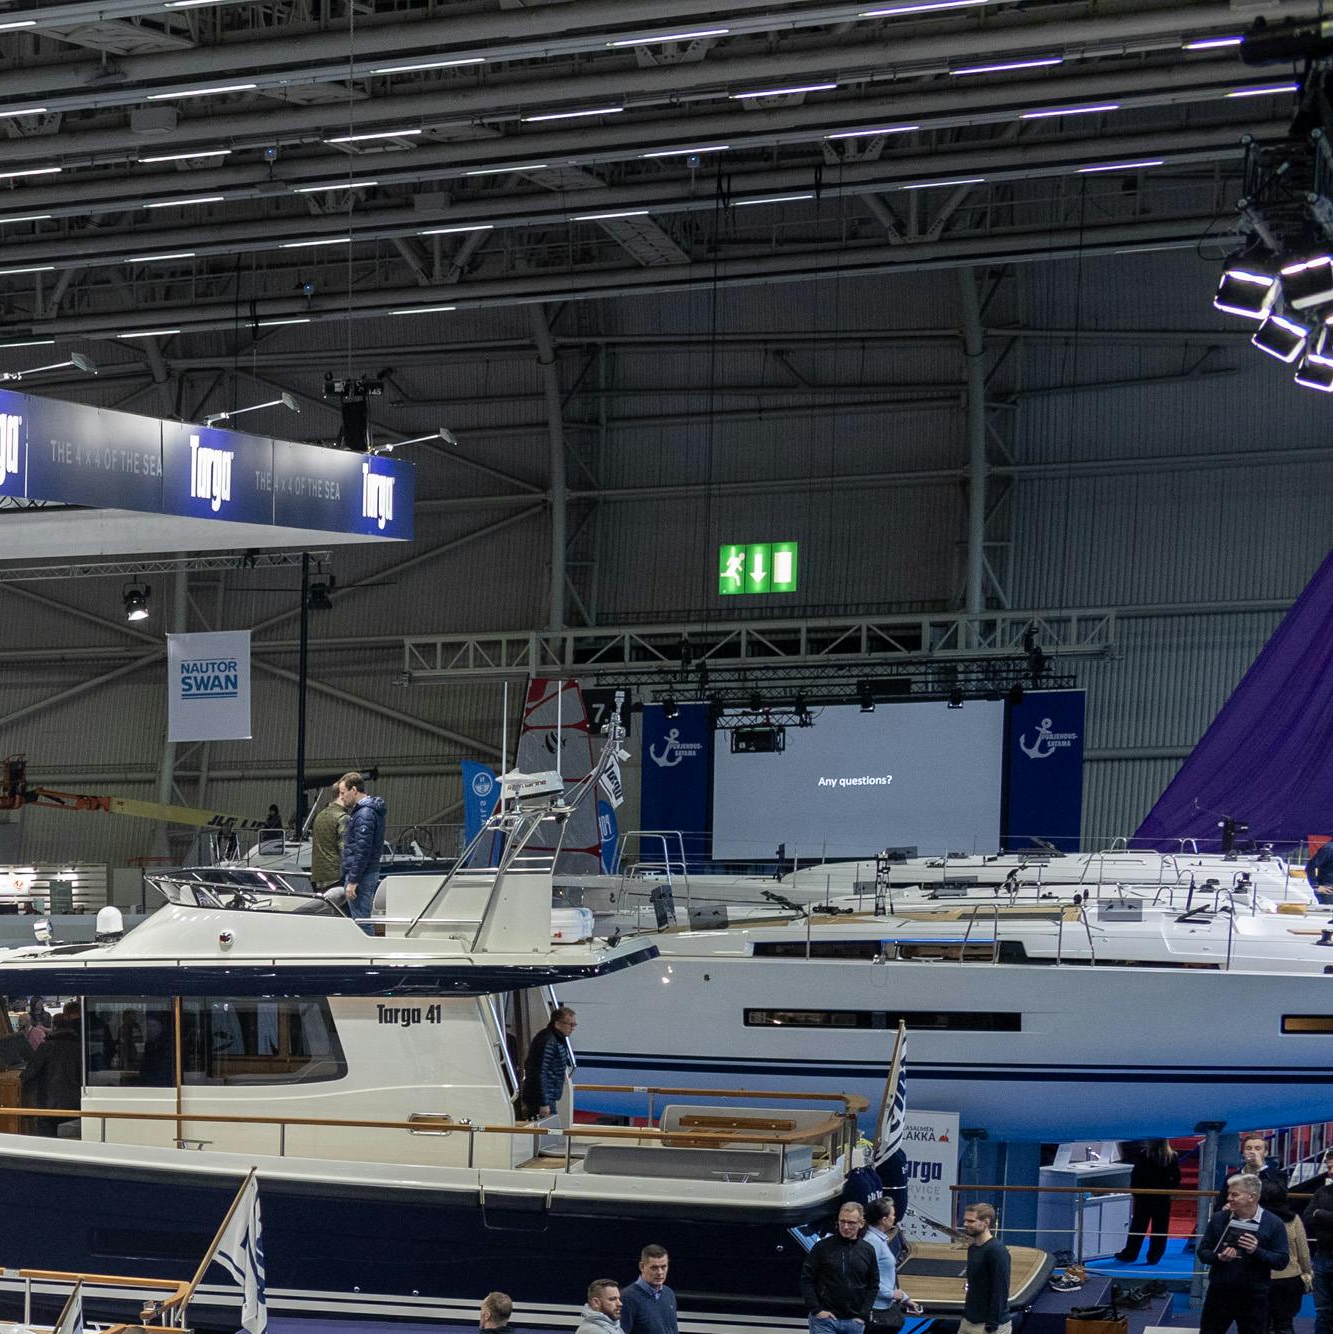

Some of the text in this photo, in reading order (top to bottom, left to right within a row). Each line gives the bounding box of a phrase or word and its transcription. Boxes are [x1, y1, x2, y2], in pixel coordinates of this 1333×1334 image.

[51, 441, 72, 465] THE
[104, 448, 118, 470] OF
[121, 450, 140, 473] THE
[142, 455, 163, 477] SEA
[190, 435, 232, 511] Targa
[255, 471, 271, 491] THE
[324, 480, 341, 500] SEA
[363, 463, 394, 529] Targa
[181, 661, 237, 674] NAUTOR
[181, 674, 238, 692] SWAN
[818, 774, 893, 789] Any questions?
[377, 1004, 442, 1027] Targa 41
